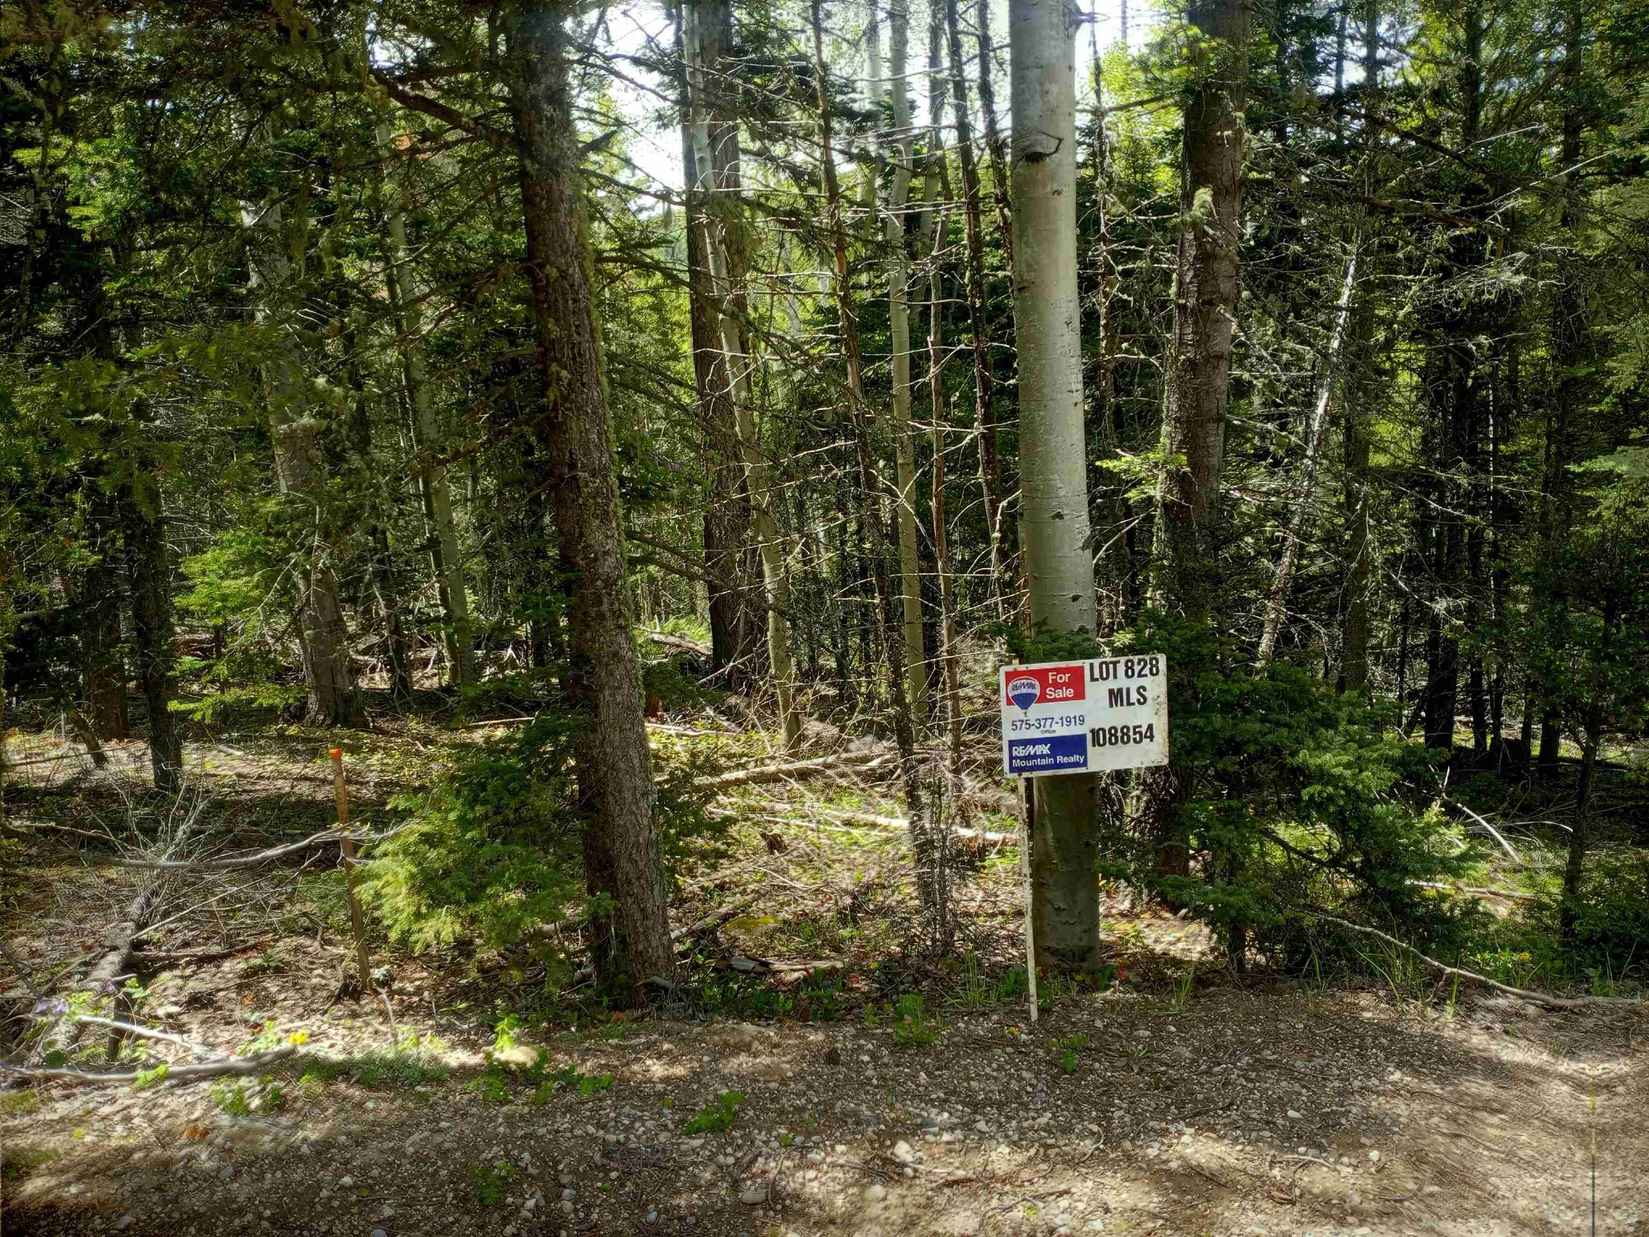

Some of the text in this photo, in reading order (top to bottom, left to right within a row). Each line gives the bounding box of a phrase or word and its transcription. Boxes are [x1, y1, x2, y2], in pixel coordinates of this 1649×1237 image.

[1089, 656, 1160, 682] LOT 828
[1048, 672, 1071, 684] For
[1046, 687, 1074, 699] Sale
[1108, 685, 1147, 708] MLS
[1011, 714, 1085, 732] 575-377-1919
[1089, 723, 1155, 748] 108854
[1012, 743, 1051, 757] RE/MAX
[1012, 754, 1085, 768] Mountain Realty
